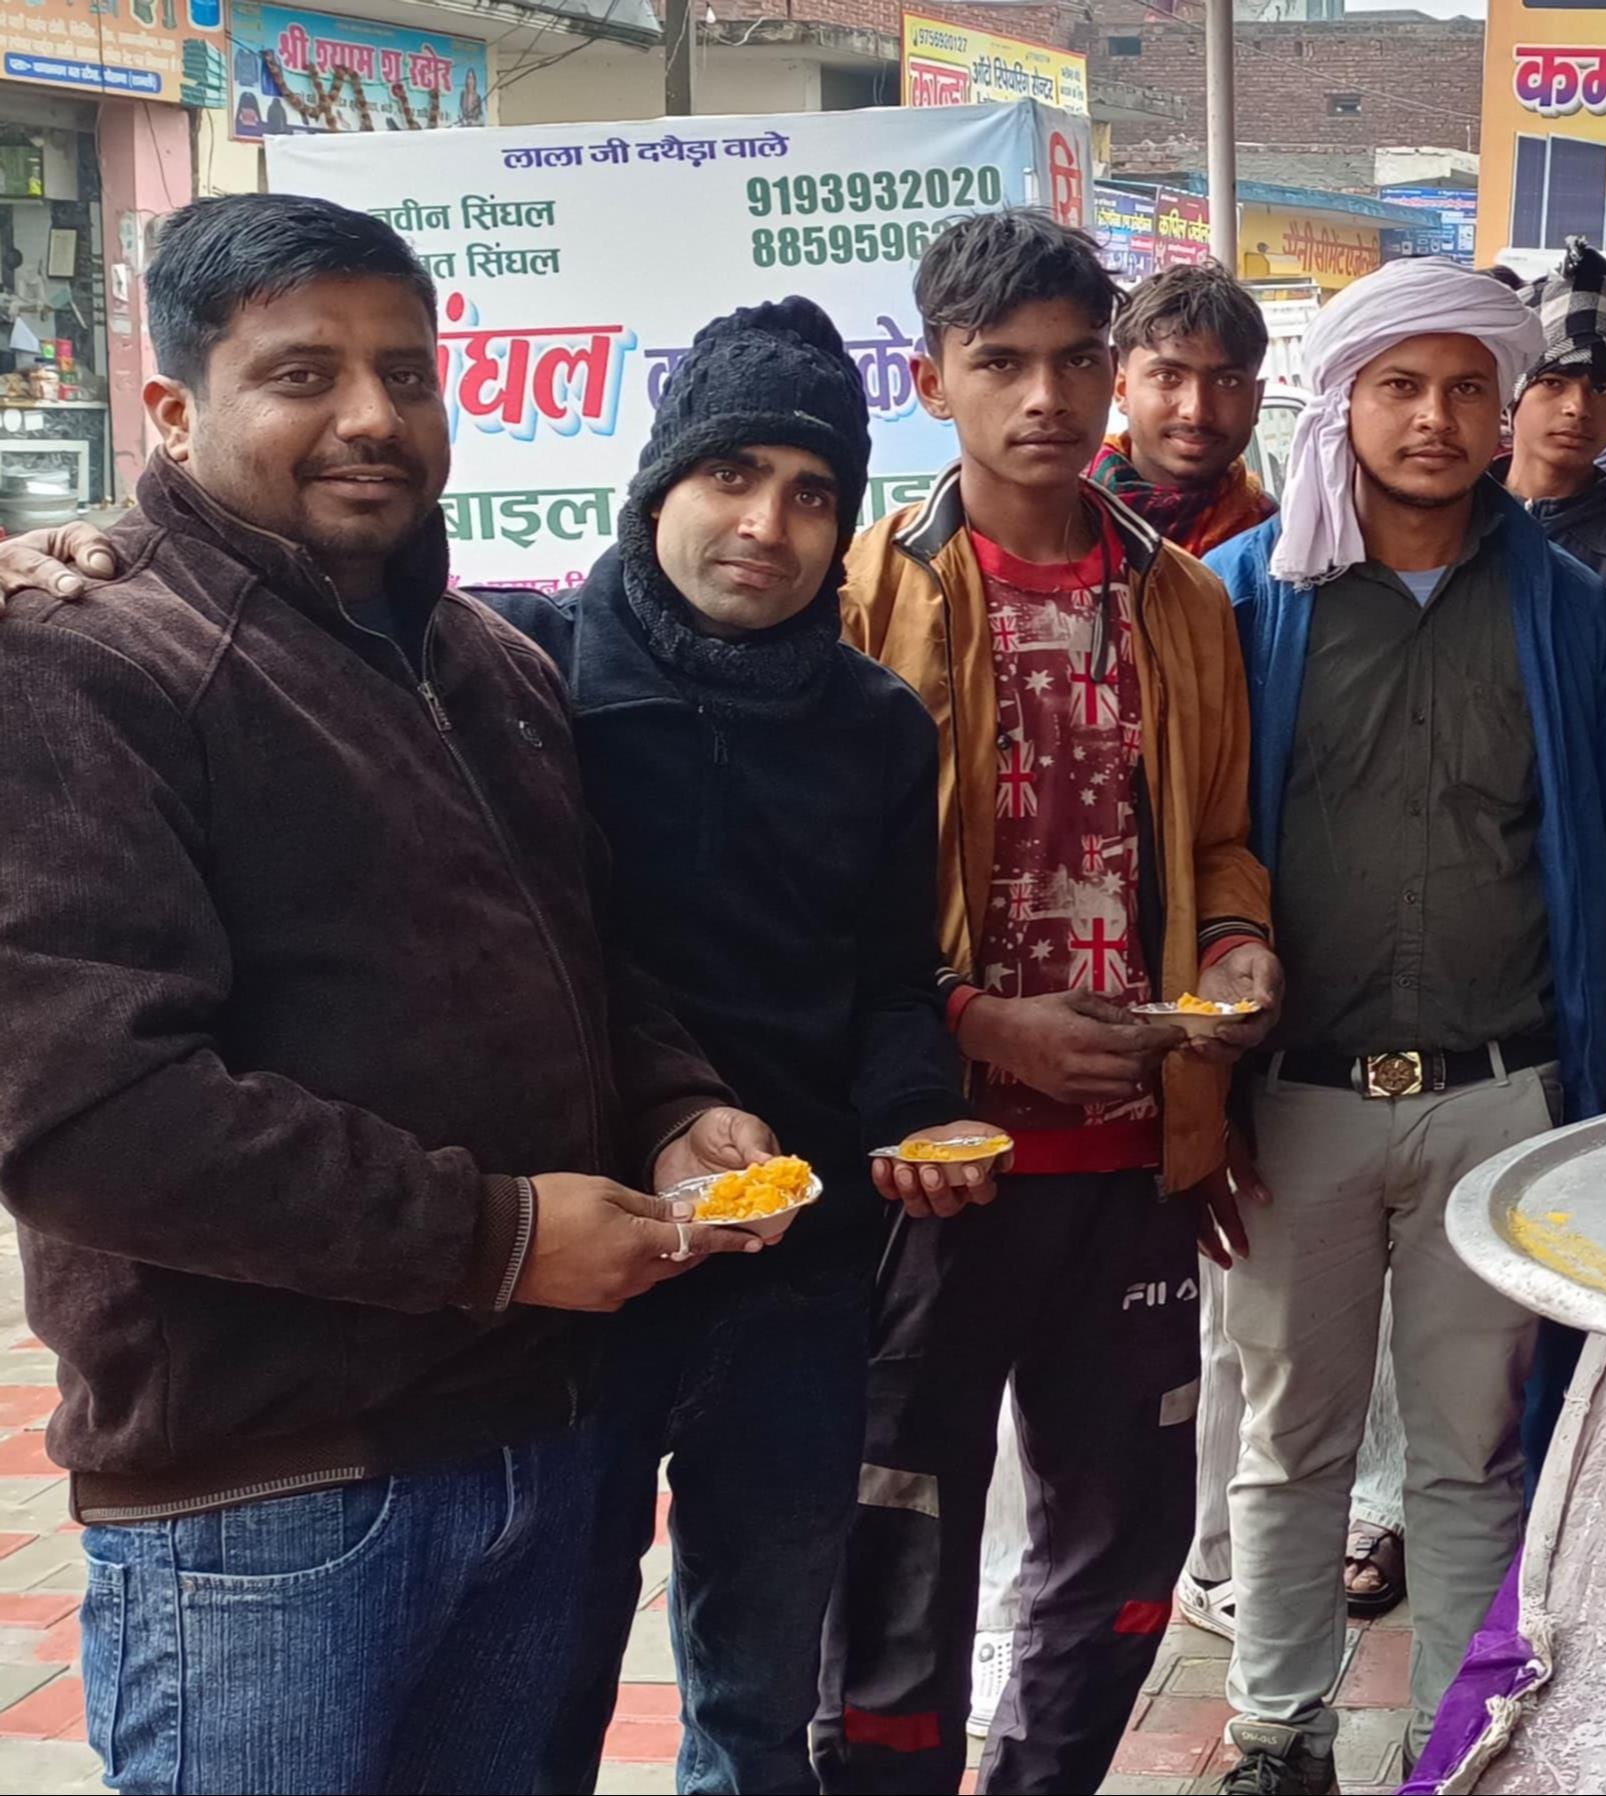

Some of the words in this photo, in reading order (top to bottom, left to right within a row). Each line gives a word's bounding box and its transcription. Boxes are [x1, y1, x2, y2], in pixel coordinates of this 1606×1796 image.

[279, 24, 309, 71] श्री
[315, 38, 375, 80] श्याम
[381, 48, 403, 99] शू
[409, 43, 453, 92] स्टोर
[502, 146, 583, 169] लाला
[589, 137, 629, 164] जी
[723, 131, 790, 158] वाले
[746, 164, 1001, 217] 9193932020
[461, 193, 556, 230] सिंघल
[466, 242, 561, 279] सिंघल
